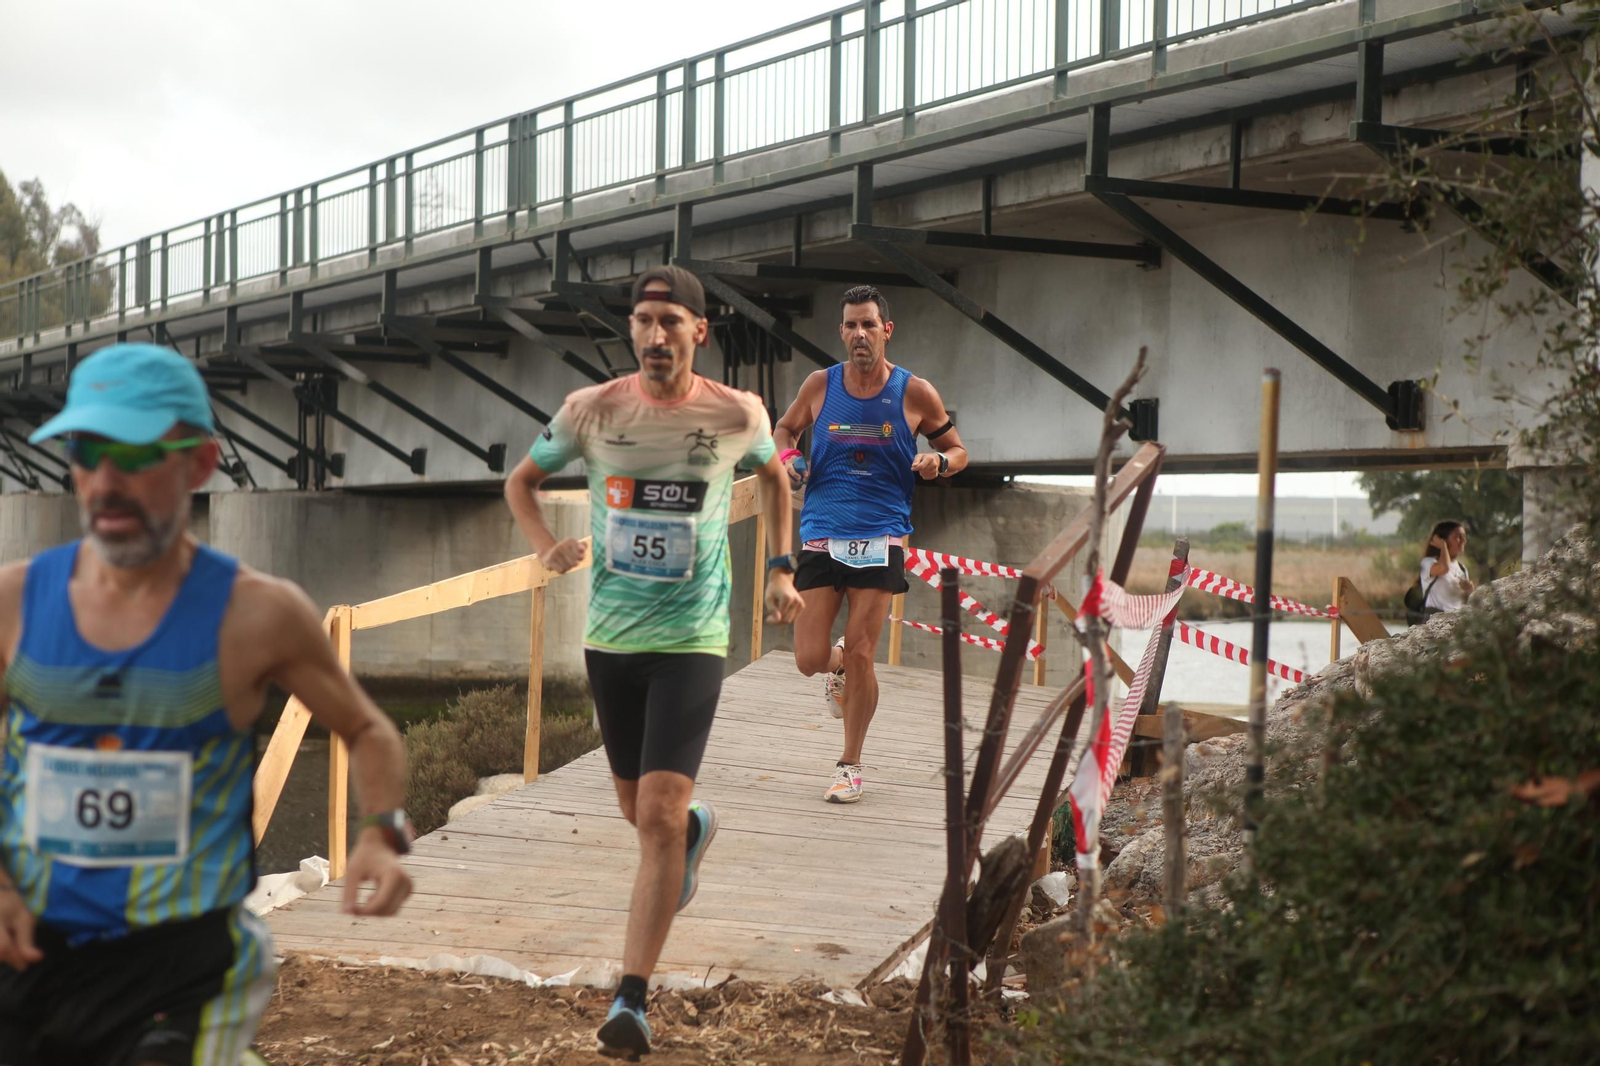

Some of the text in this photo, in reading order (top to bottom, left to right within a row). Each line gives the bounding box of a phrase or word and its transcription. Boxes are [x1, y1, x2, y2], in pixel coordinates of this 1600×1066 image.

[642, 484, 697, 503] SOL
[633, 534, 666, 560] 55
[847, 540, 870, 556] 87
[76, 789, 134, 830] 69
